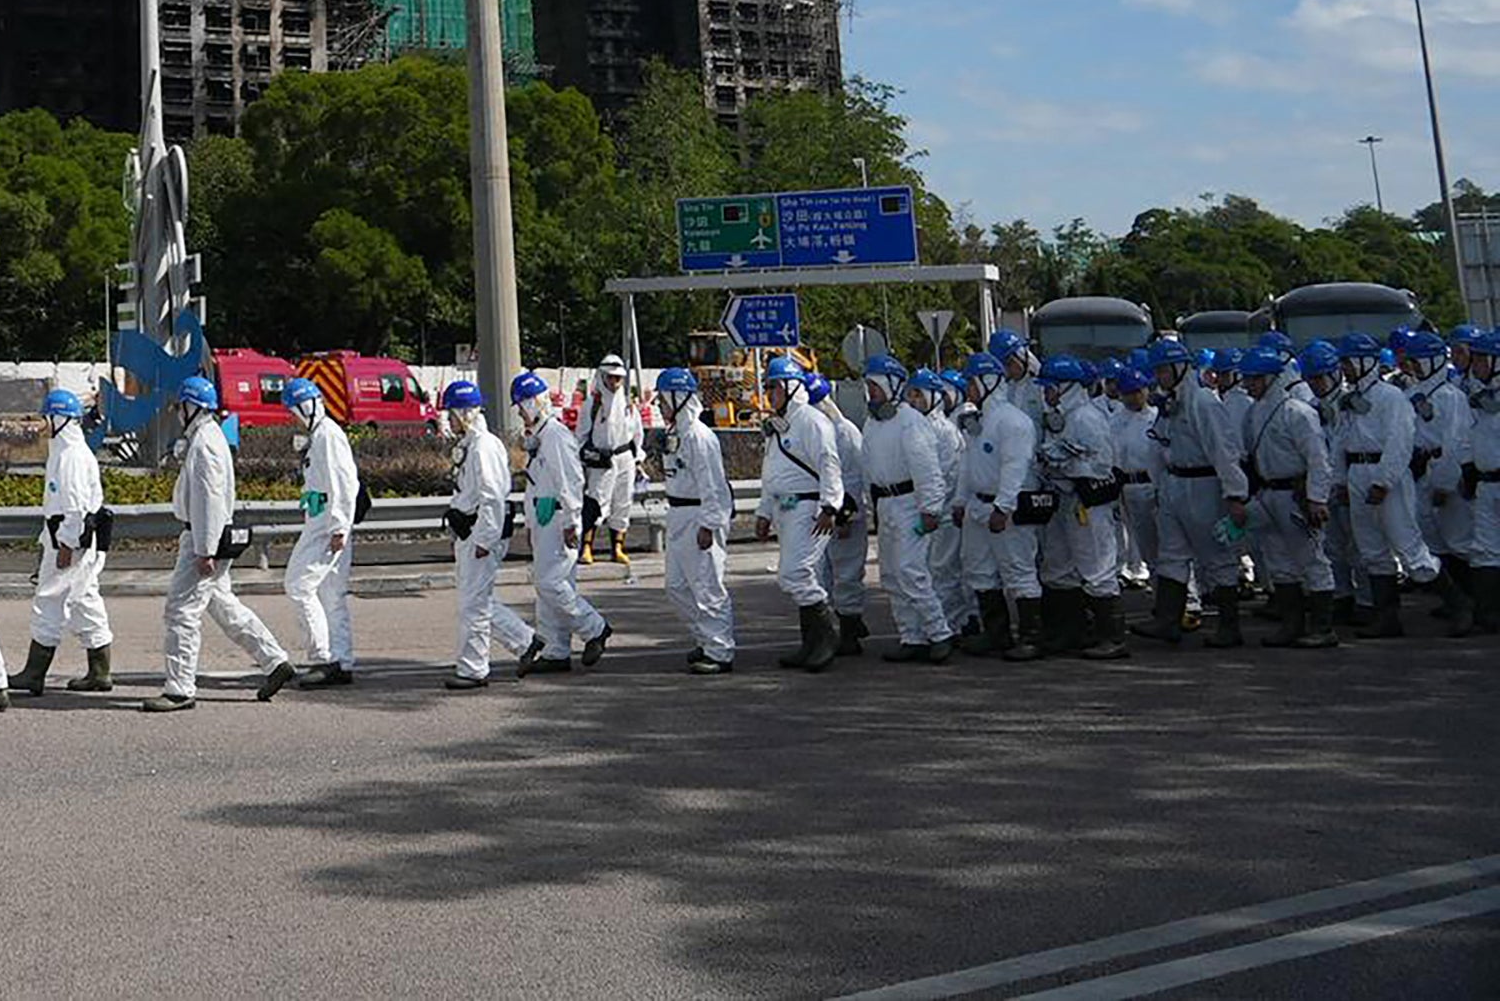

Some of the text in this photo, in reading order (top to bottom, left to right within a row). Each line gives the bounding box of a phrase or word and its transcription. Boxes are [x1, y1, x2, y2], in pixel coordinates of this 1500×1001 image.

[780, 198, 798, 207] Sha
[799, 197, 814, 206] Tin
[684, 216, 709, 228] 沙田
